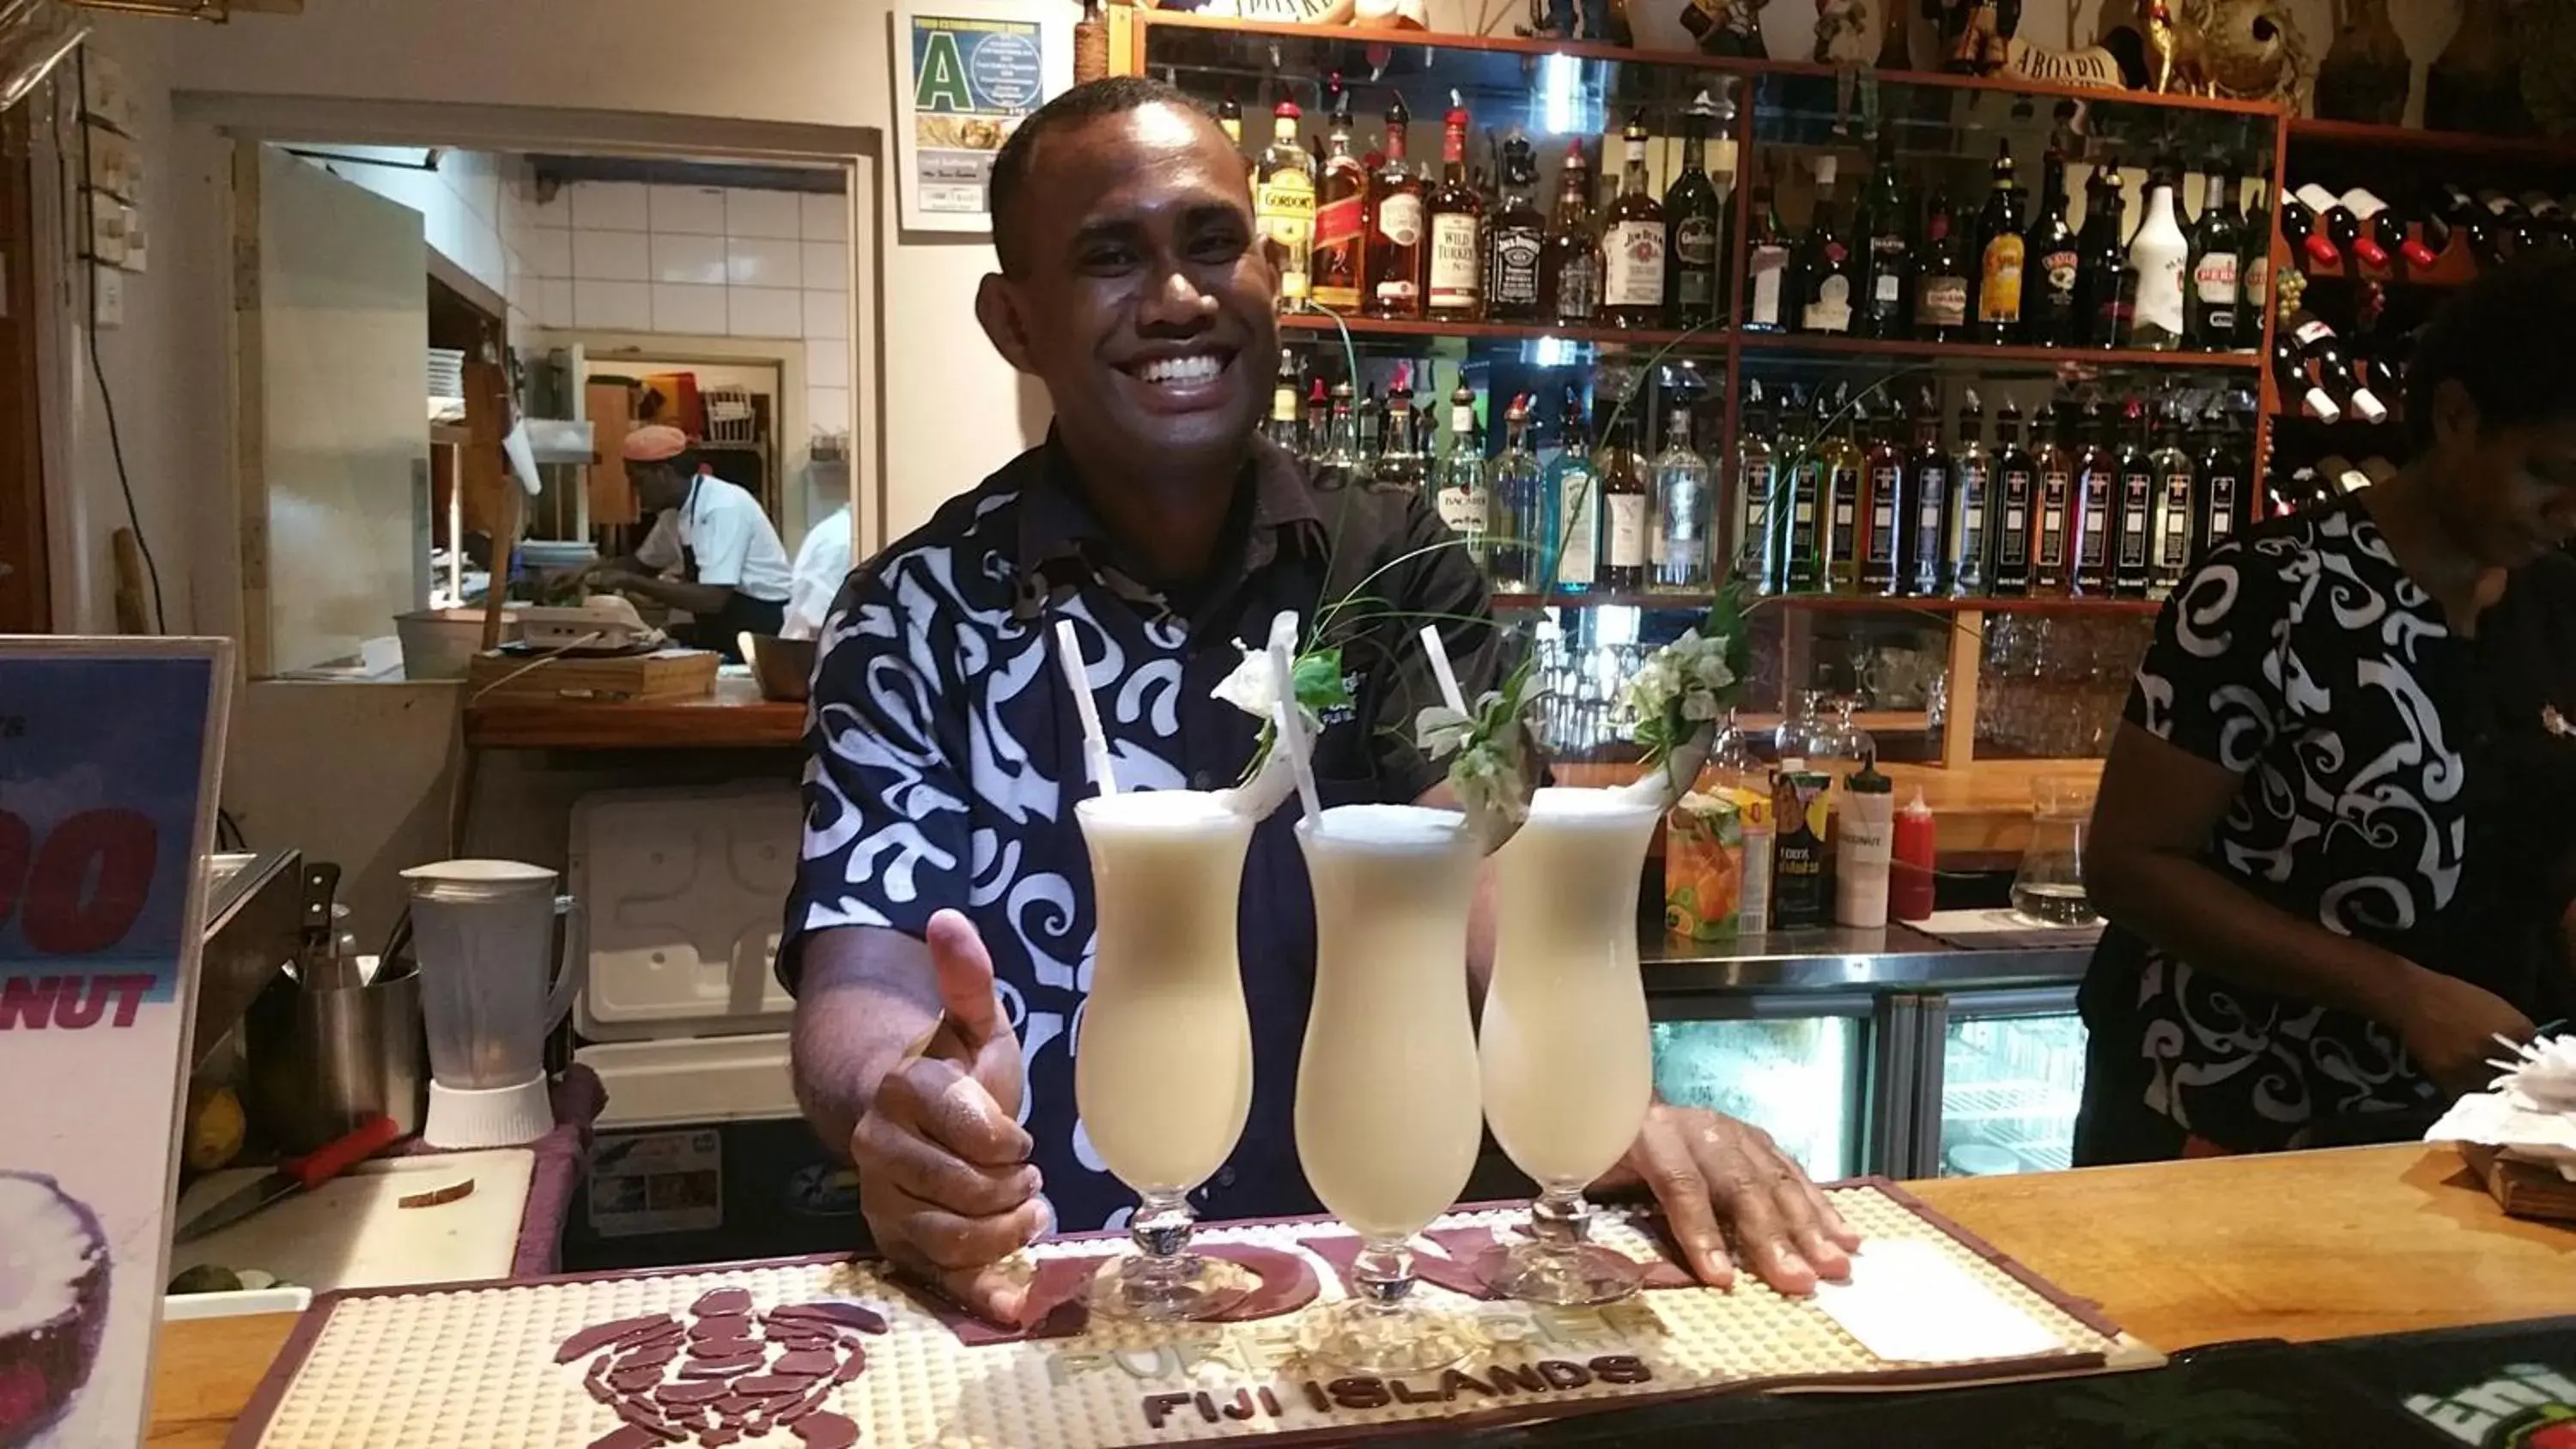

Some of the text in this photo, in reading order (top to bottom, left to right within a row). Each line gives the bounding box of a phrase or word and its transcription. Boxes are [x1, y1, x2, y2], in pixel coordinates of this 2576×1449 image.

[914, 31, 975, 112] A
[1438, 244, 1473, 261] TURKEY
[1443, 231, 1470, 246] WILD
[1142, 1355, 1653, 1429] FIJI ISLANDS
